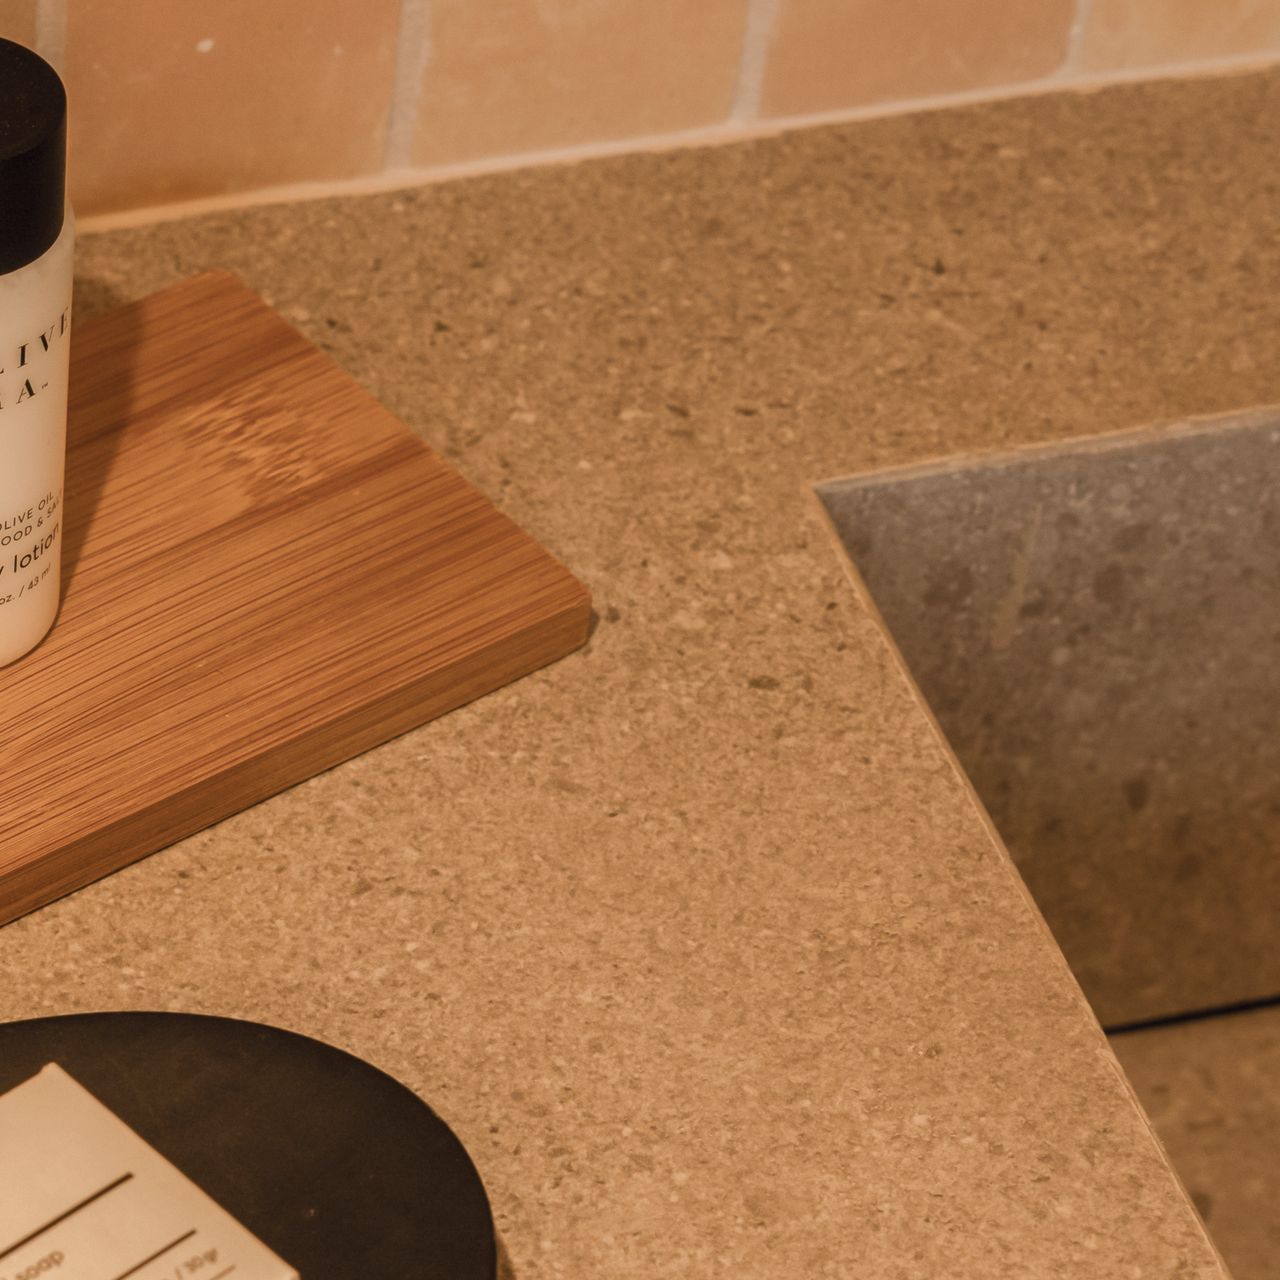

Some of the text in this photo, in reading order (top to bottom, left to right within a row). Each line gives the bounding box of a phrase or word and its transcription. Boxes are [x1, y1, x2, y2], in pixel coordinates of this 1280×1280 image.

[38, 491, 54, 511] OIL
[36, 516, 44, 528] &
[13, 522, 59, 573] lotion
[18, 584, 25, 598] /
[27, 576, 39, 590] 43
